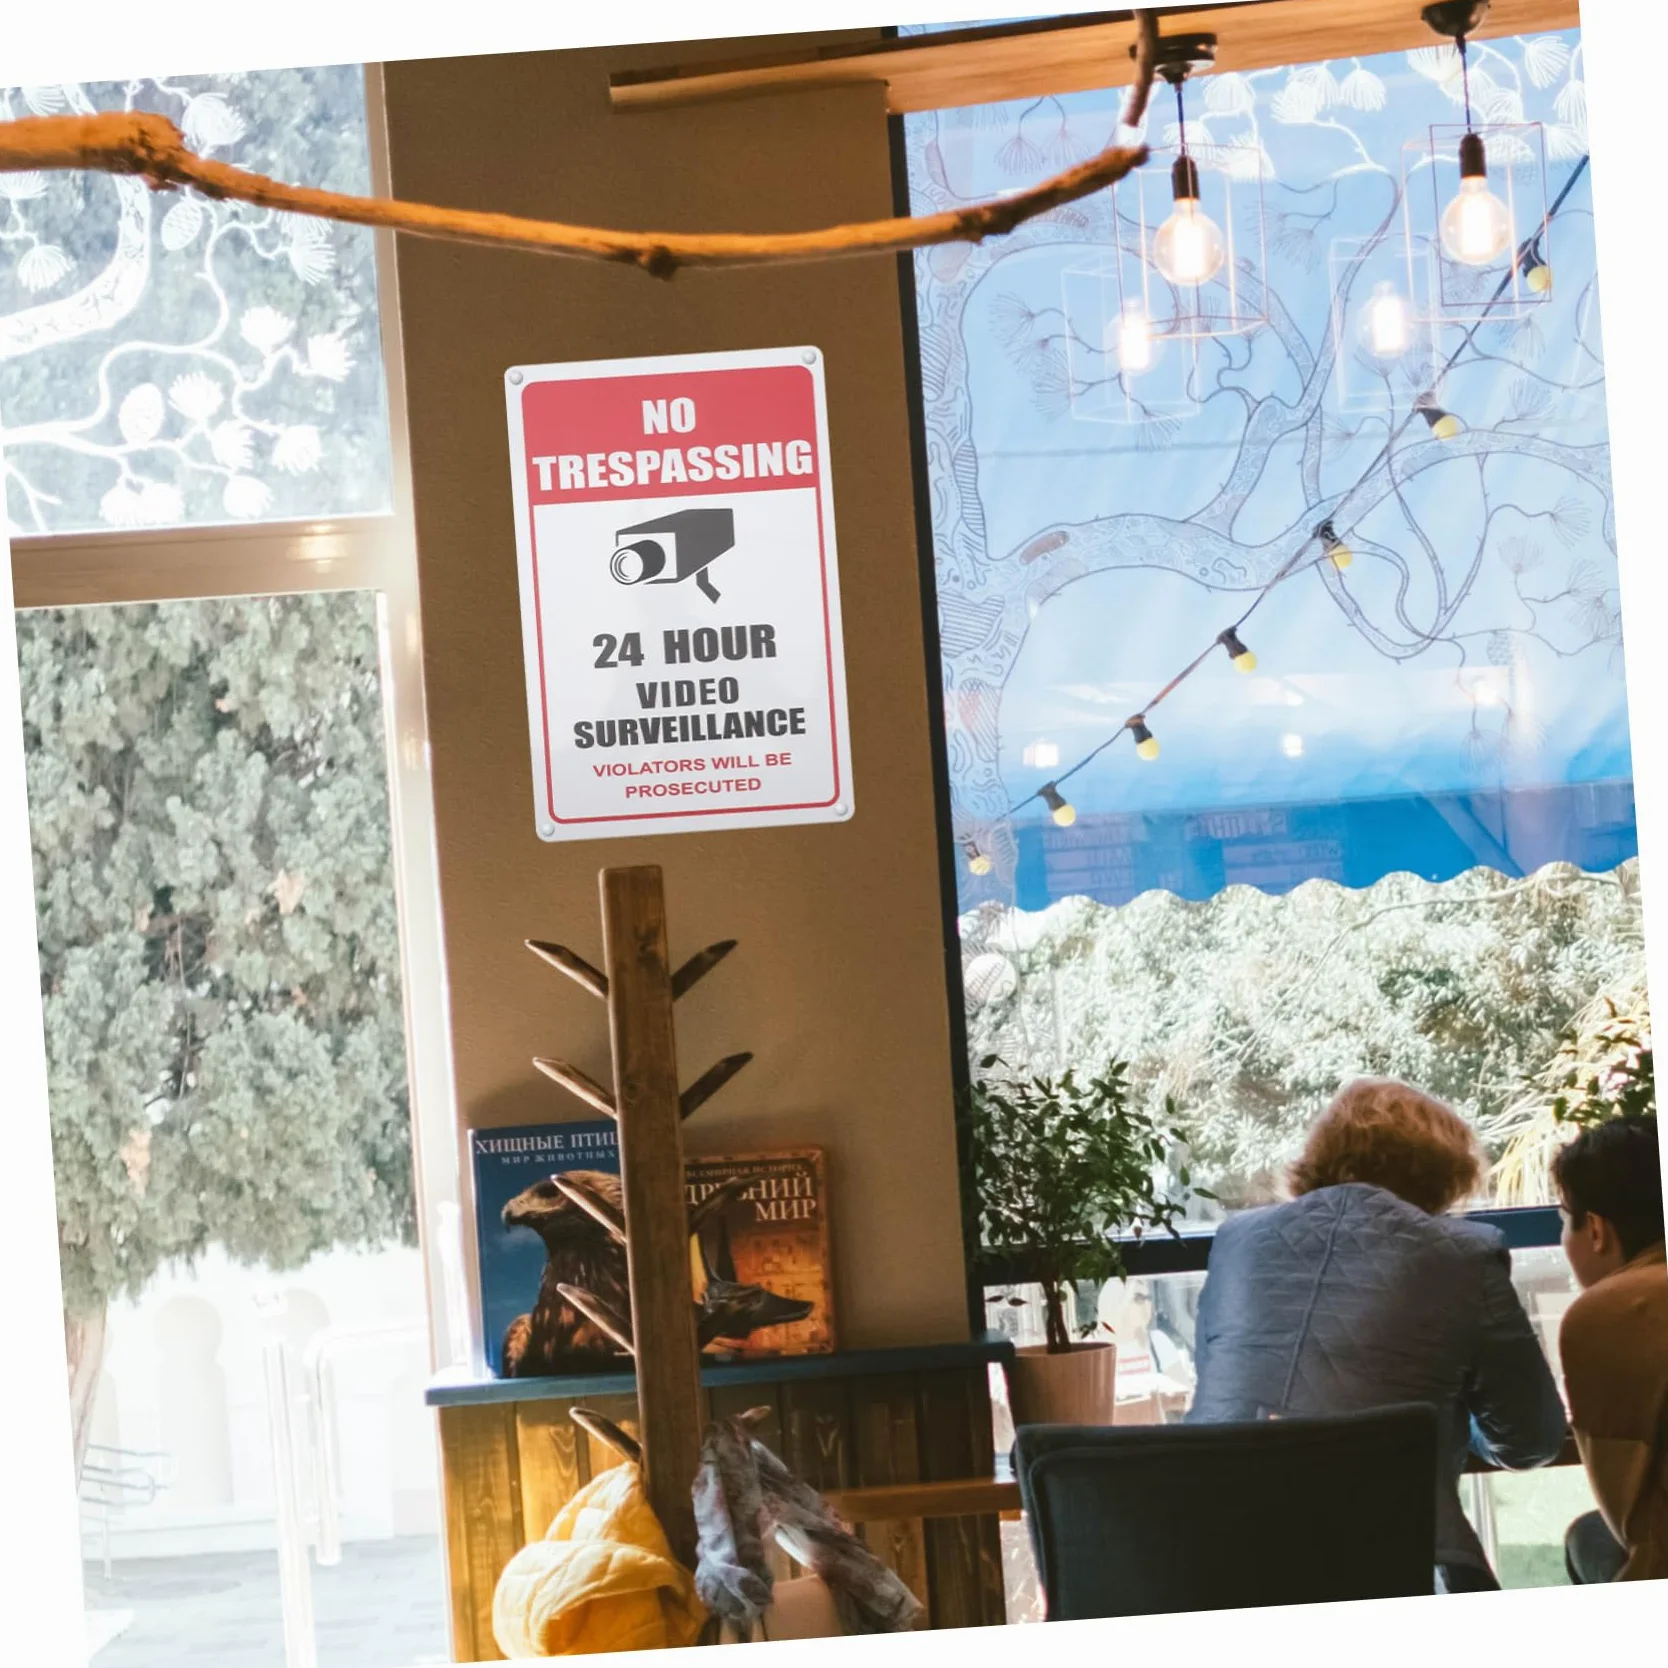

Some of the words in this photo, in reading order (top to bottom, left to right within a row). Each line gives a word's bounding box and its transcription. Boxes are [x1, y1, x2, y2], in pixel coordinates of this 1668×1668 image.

[641, 397, 696, 435] NO
[532, 439, 813, 491] TRESPASSING
[592, 632, 644, 669] 24
[663, 624, 777, 665] HOUR
[636, 677, 739, 709] VIDEO
[573, 707, 806, 749] SURVEILLANCE
[592, 757, 706, 777] VIOLATORS
[712, 754, 760, 771] WILL
[765, 751, 792, 767] BE
[625, 778, 762, 799] PROSECUTED
[475, 1135, 565, 1154] ХИЩНЫЕ
[500, 1155, 531, 1165] МИР
[534, 1149, 616, 1163] ЖИВОТНЫХ
[685, 1172, 811, 1206] ДРНИЙ
[755, 1199, 817, 1222] МИР
